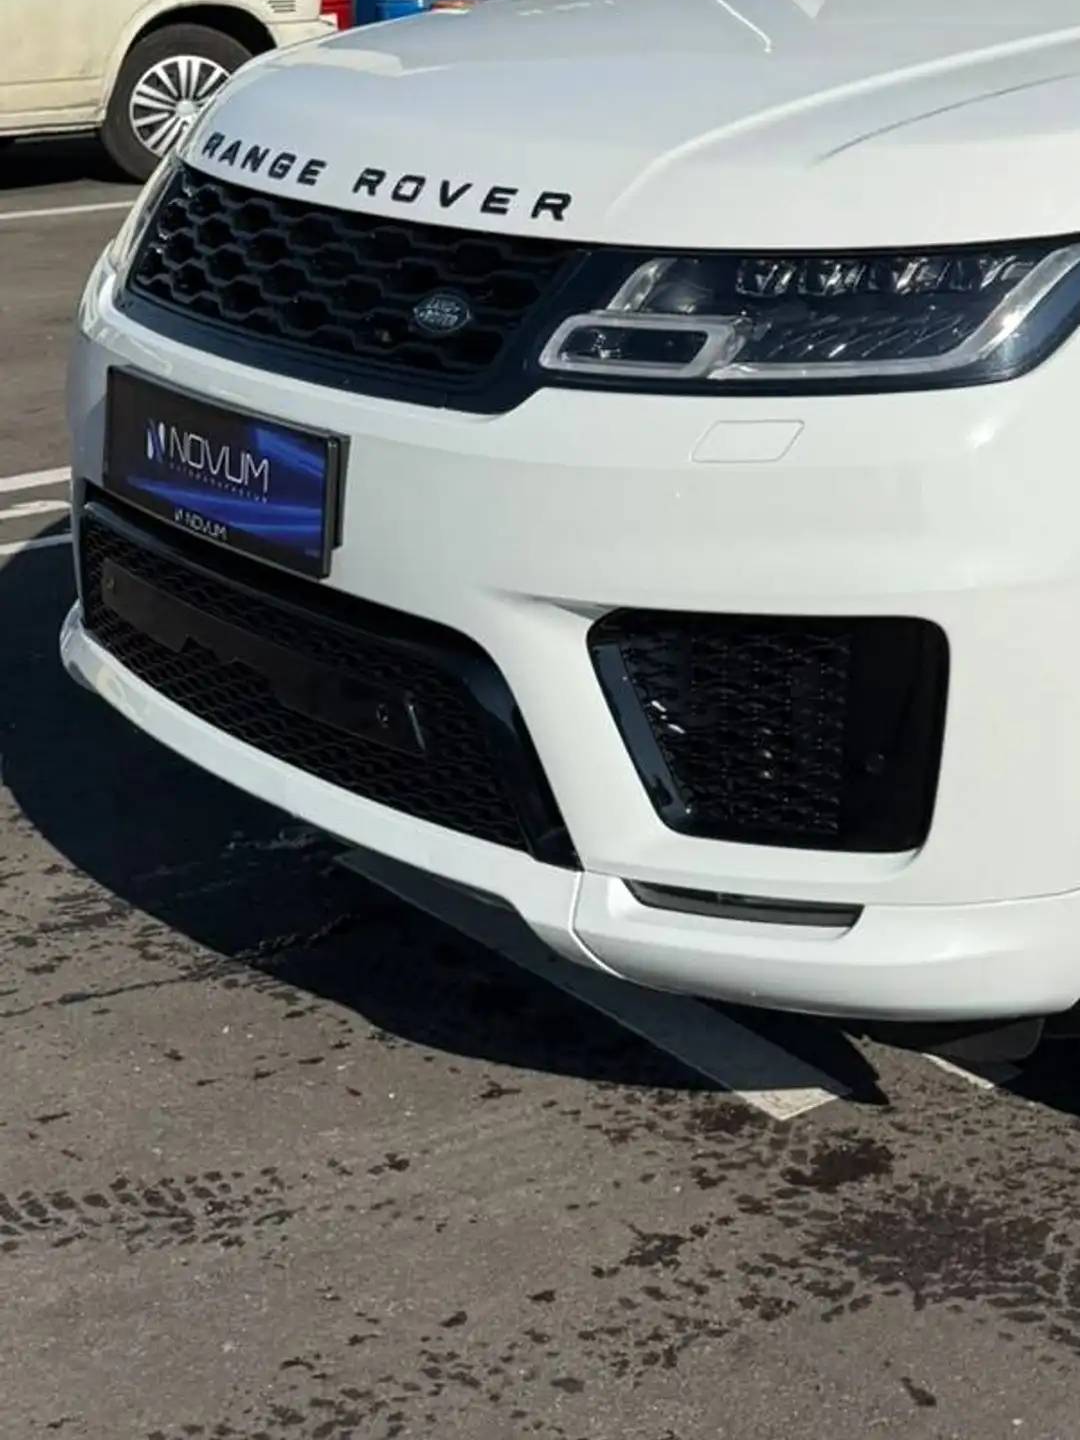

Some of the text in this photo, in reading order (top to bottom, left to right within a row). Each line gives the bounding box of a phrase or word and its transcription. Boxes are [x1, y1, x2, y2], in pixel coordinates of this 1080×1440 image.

[202, 132, 573, 221] RANGE ROVER
[169, 426, 269, 493] NOVUM
